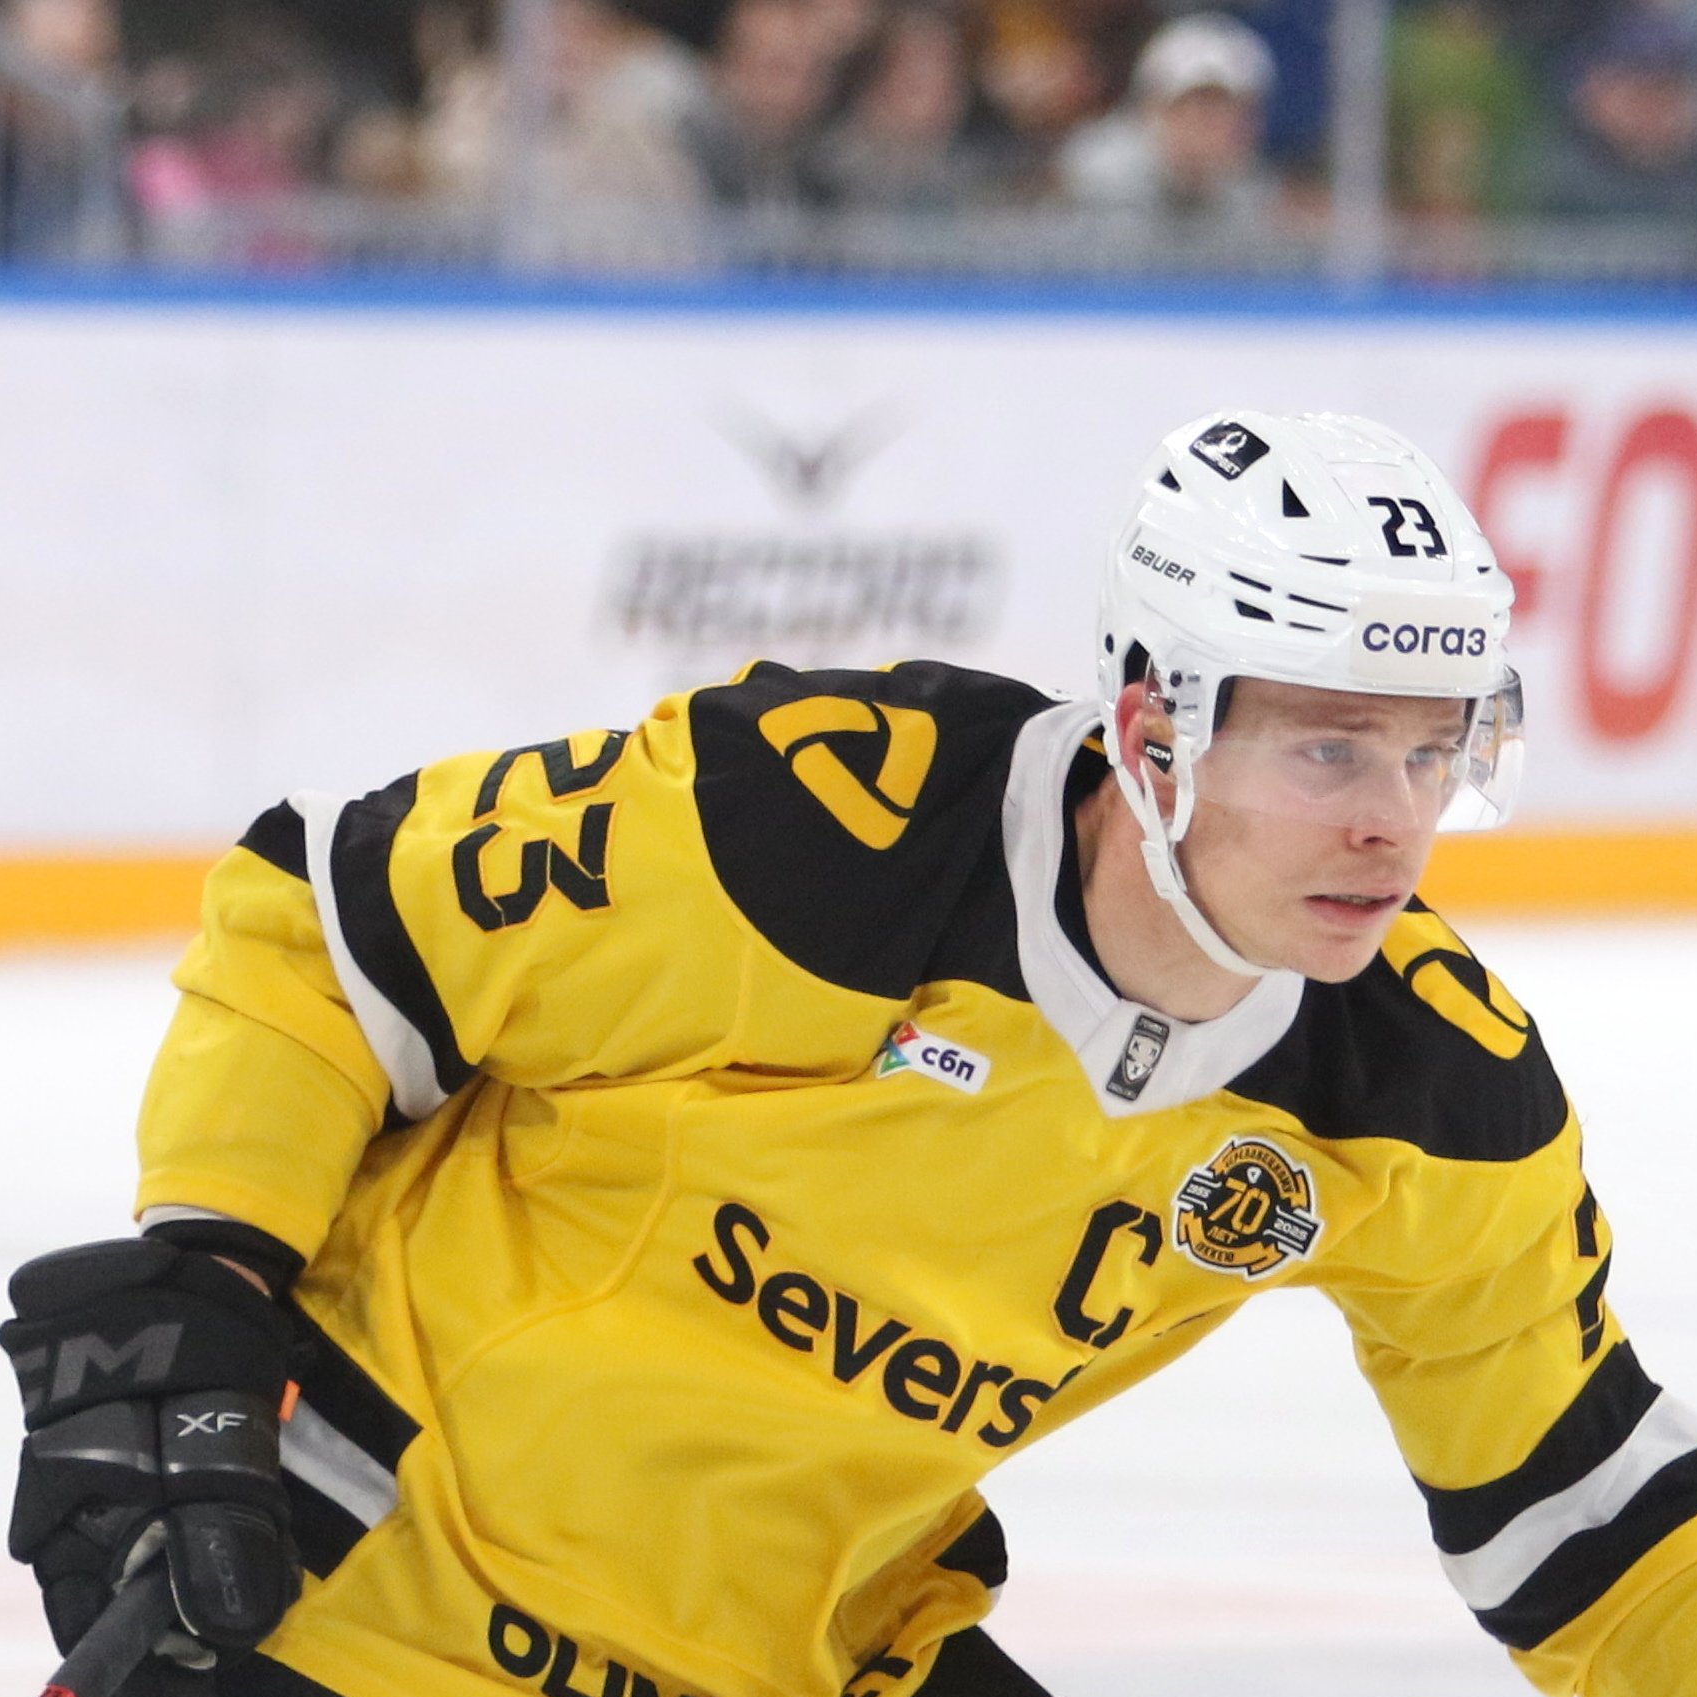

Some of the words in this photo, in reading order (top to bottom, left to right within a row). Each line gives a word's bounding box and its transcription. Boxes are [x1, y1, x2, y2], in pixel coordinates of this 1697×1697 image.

[1367, 496, 1448, 558] 23
[1131, 544, 1196, 587] BAUER
[1145, 745, 1171, 761] CCM
[451, 728, 636, 934] 23
[1208, 1176, 1271, 1235] 70
[1054, 1200, 1164, 1351] C
[691, 1202, 1085, 1448] Severs
[176, 1411, 249, 1438] XF
